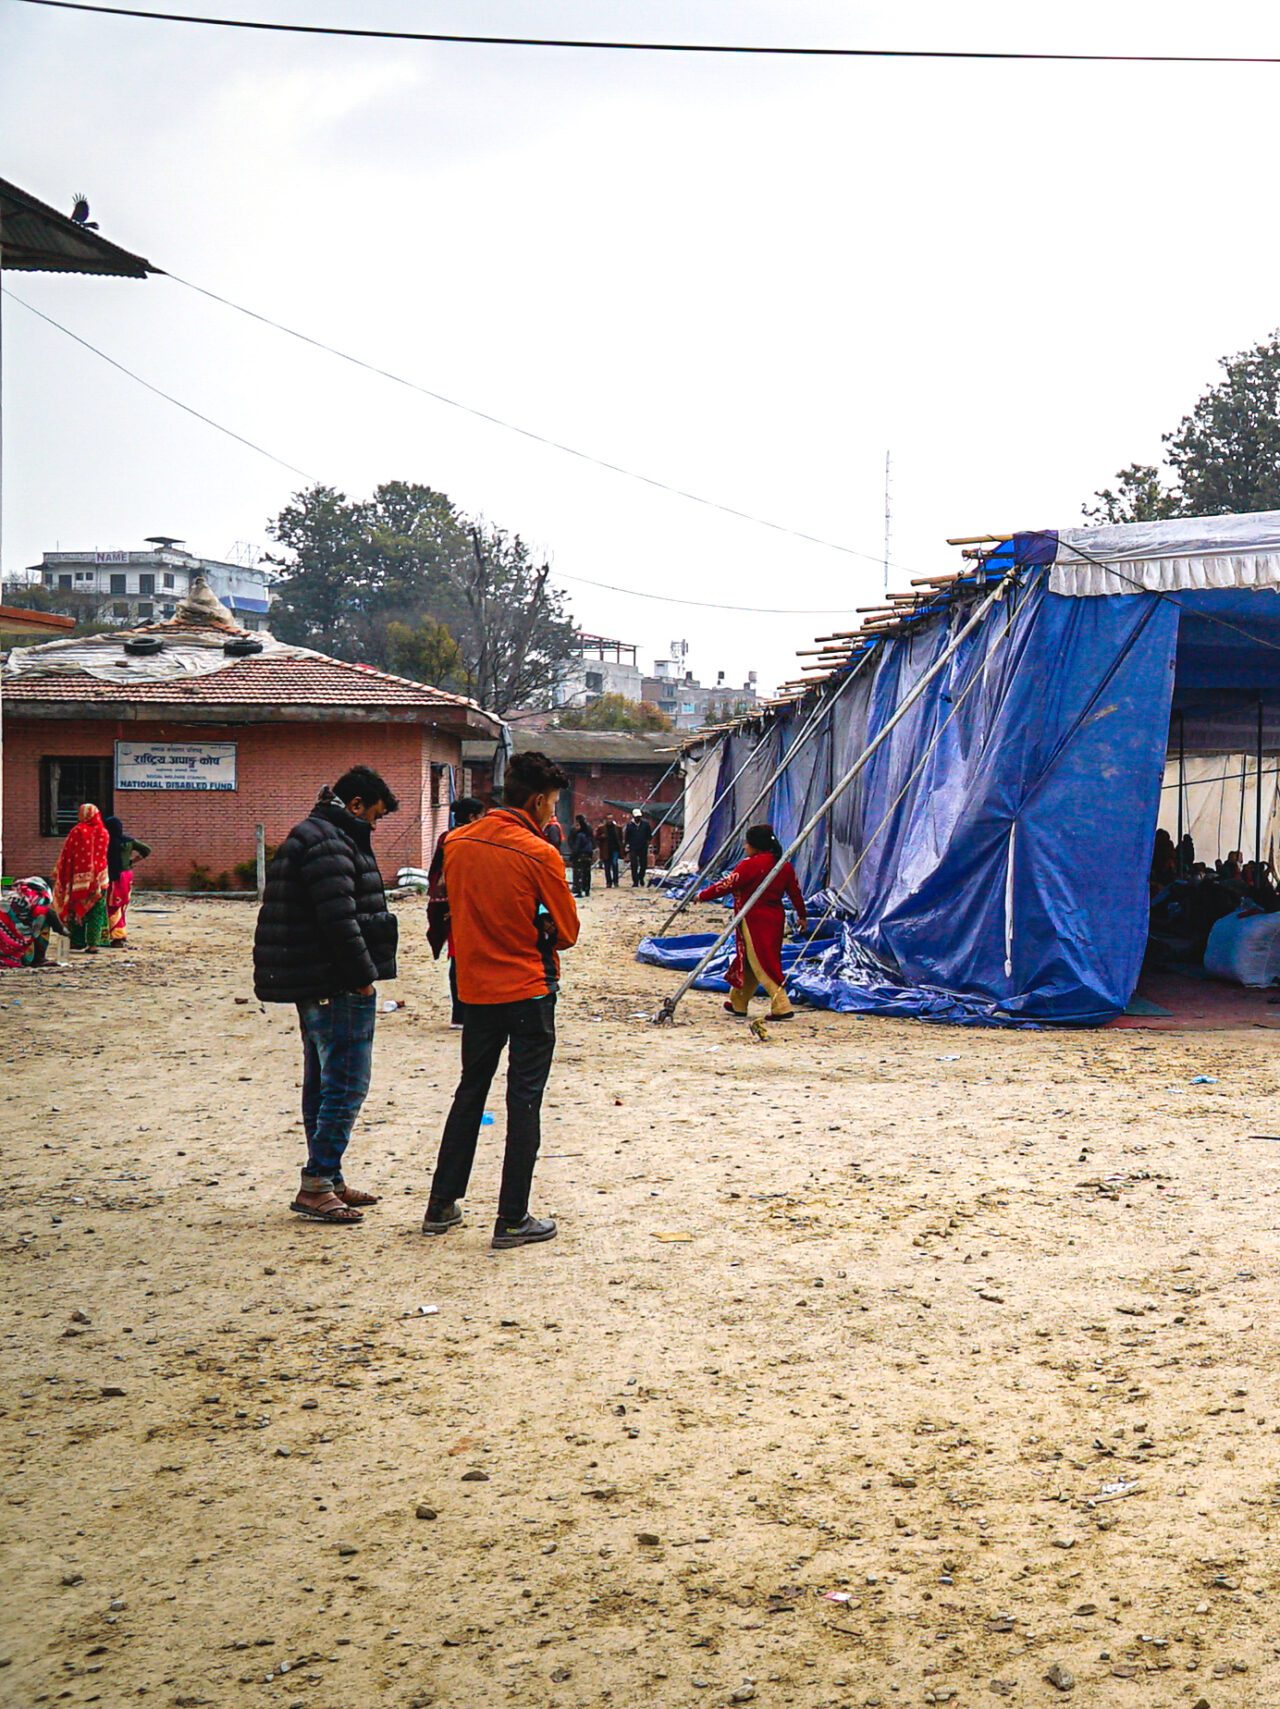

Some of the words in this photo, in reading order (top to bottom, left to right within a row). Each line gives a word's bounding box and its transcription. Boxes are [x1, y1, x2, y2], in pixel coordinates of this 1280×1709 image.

[97, 553, 127, 562] NAME
[200, 754, 220, 766] कोष
[120, 781, 163, 789] NATIONAL
[166, 782, 208, 790] DISABLED
